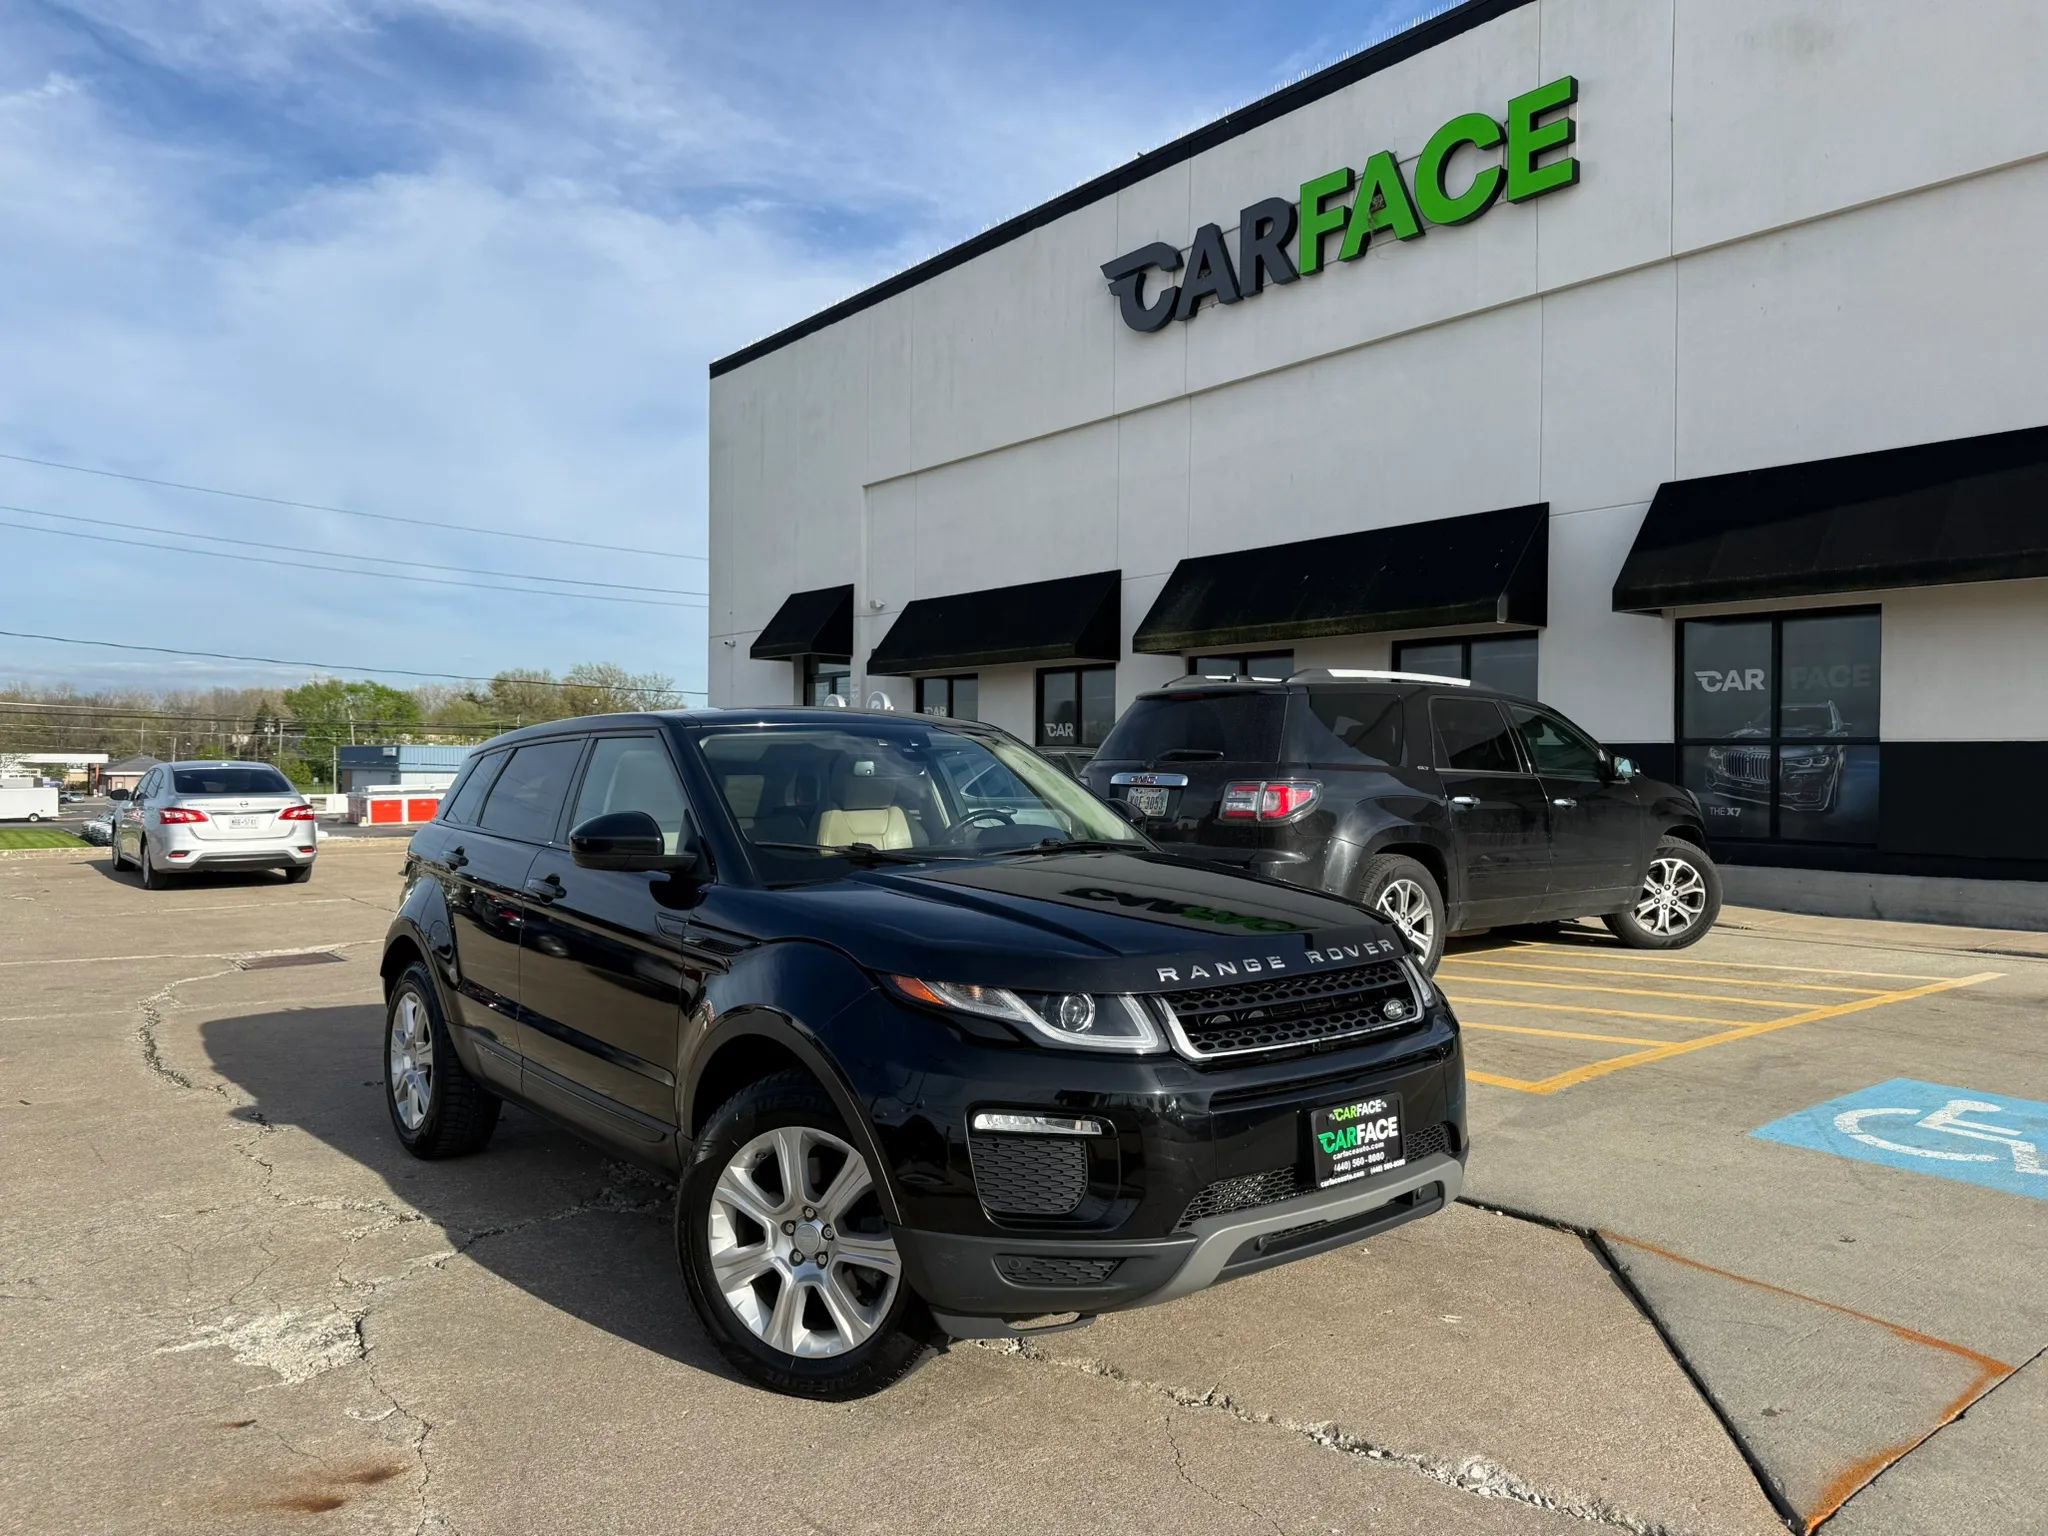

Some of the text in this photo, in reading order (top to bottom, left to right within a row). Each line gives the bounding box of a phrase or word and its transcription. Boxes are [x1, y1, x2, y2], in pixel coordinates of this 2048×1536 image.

[1100, 75, 1580, 333] CARFACE
[1694, 668, 1766, 693] CAR
[1045, 722, 1074, 737] CAR
[1709, 807, 1742, 817] THE X7
[1156, 939, 1395, 982] RANGE ROVER
[1333, 1099, 1382, 1121] CARFACE
[1318, 1116, 1399, 1153] CARFACE
